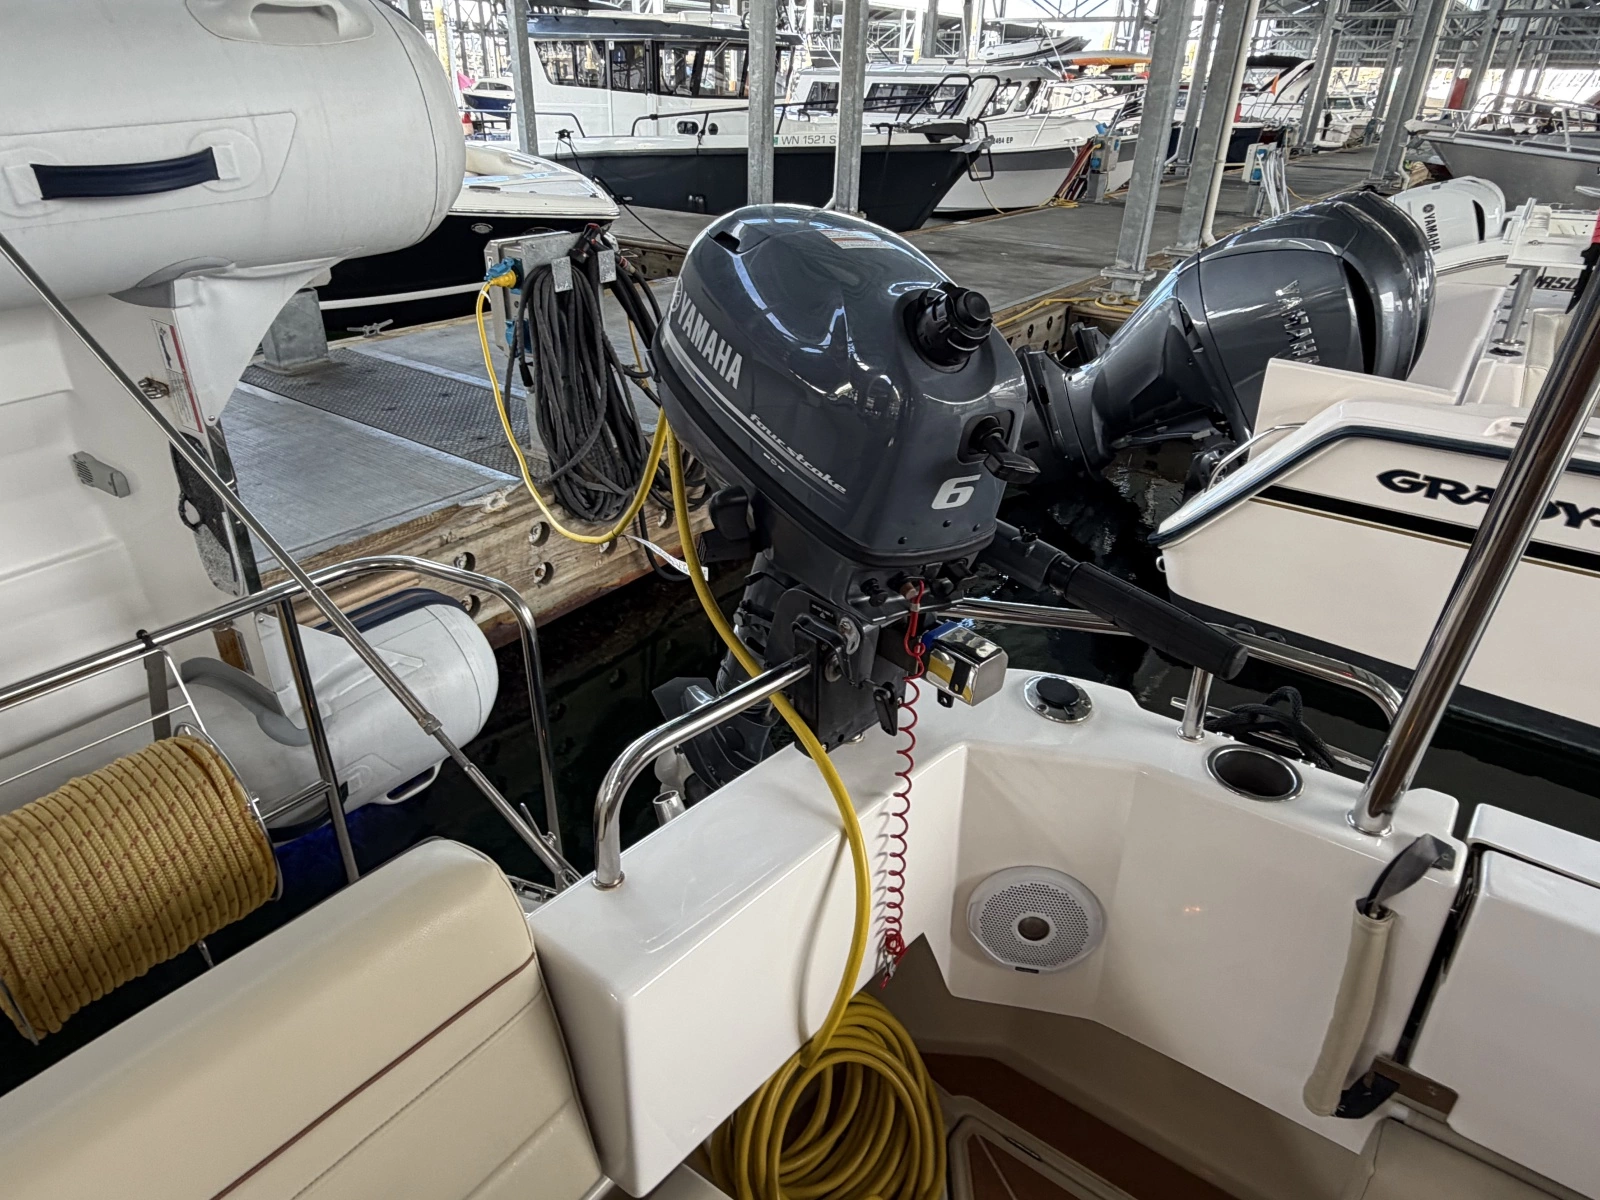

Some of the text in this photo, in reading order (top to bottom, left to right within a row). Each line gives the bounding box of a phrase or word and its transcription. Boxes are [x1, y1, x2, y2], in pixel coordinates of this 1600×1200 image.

[781, 135, 800, 145] WN
[803, 135, 826, 144] 1521
[1006, 136, 1014, 144] EP
[1423, 212, 1442, 251] YAMAHA
[678, 291, 743, 390] YAMAHA
[931, 474, 982, 510] 6
